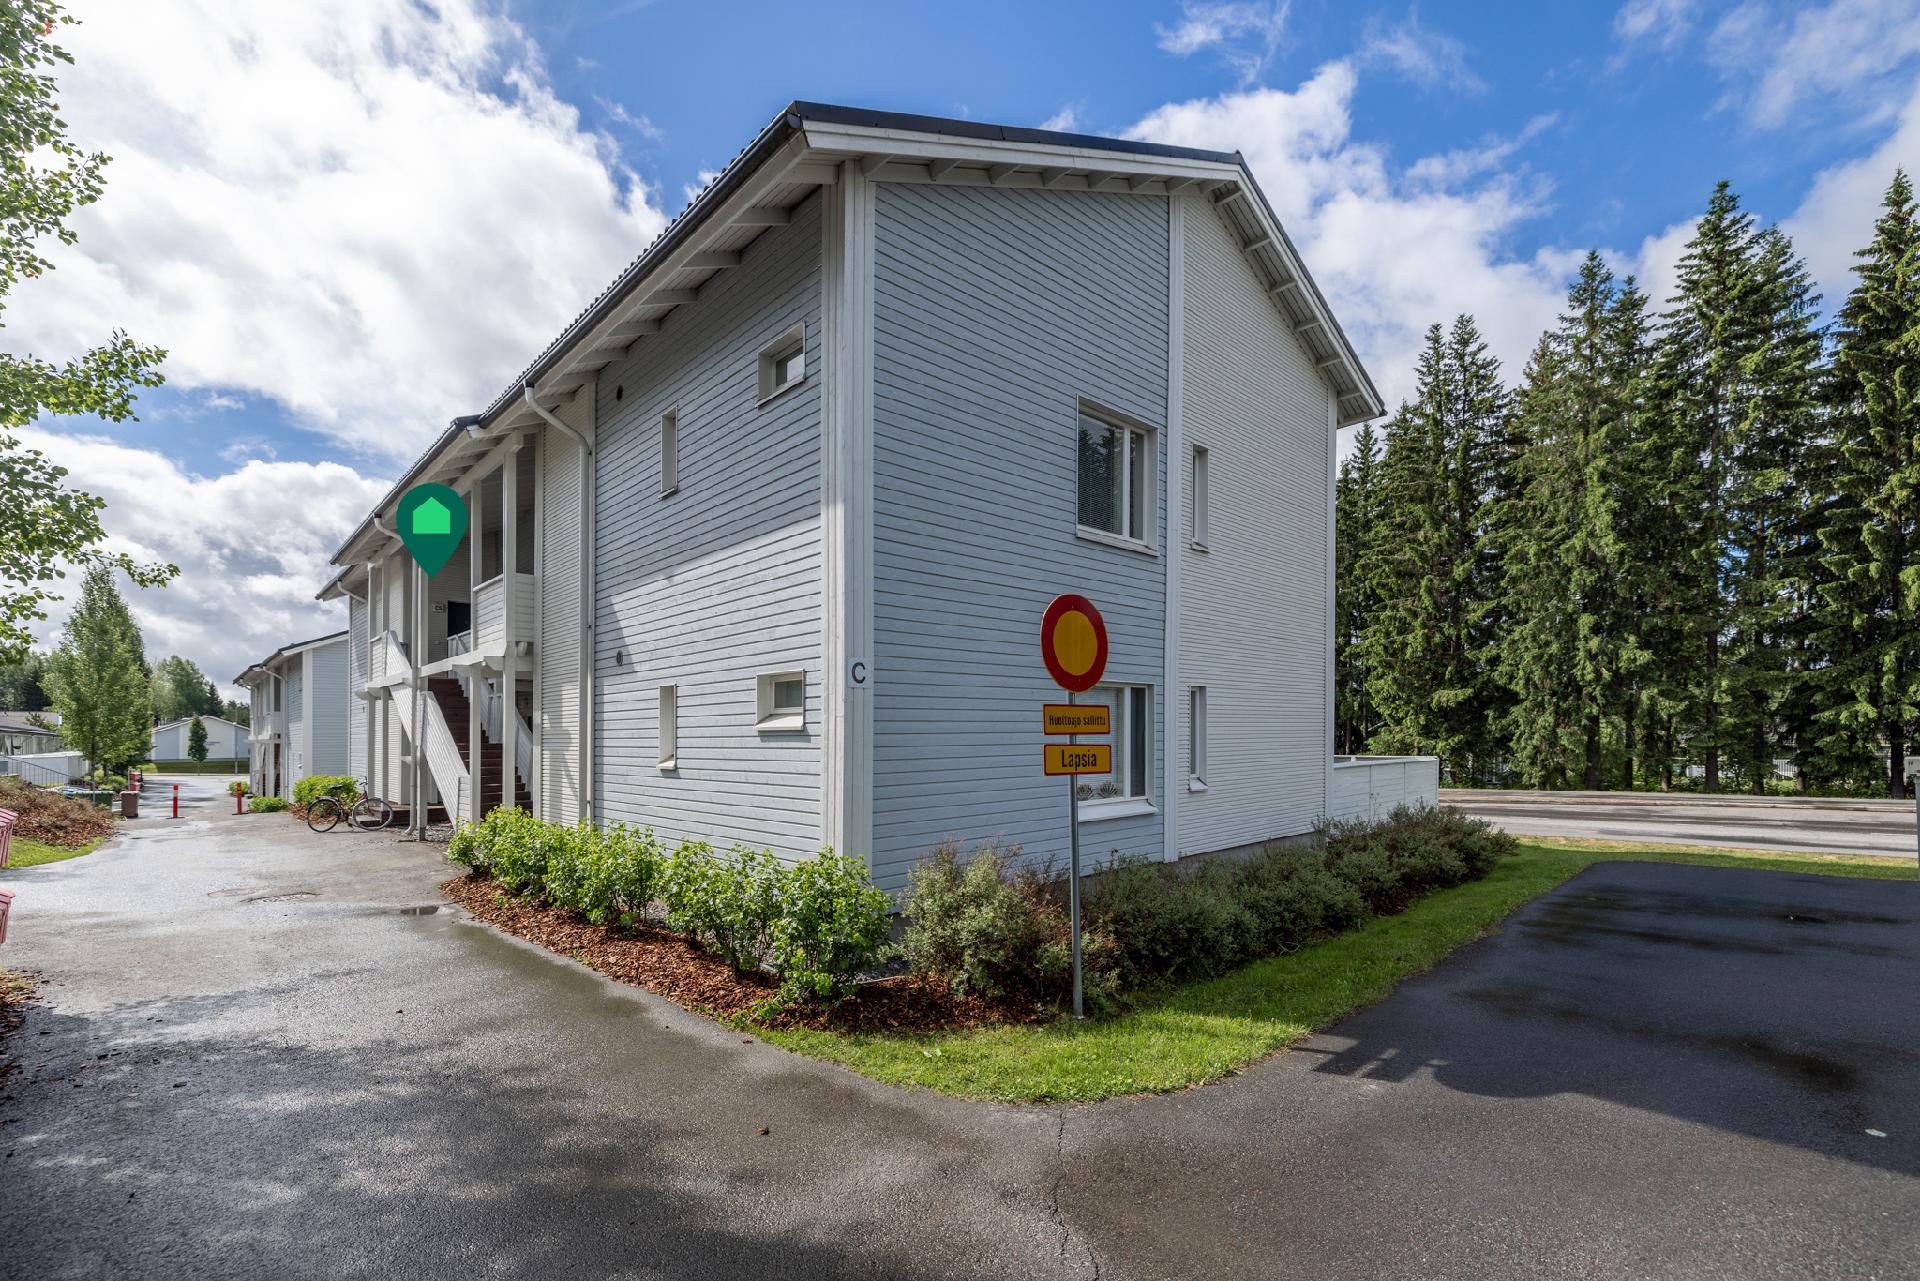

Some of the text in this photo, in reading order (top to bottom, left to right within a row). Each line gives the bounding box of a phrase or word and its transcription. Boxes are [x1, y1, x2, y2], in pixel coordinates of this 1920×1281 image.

[852, 662, 866, 684] C
[1049, 715, 1081, 728] Huoltoajo
[1061, 749, 1097, 771] Lapsia
